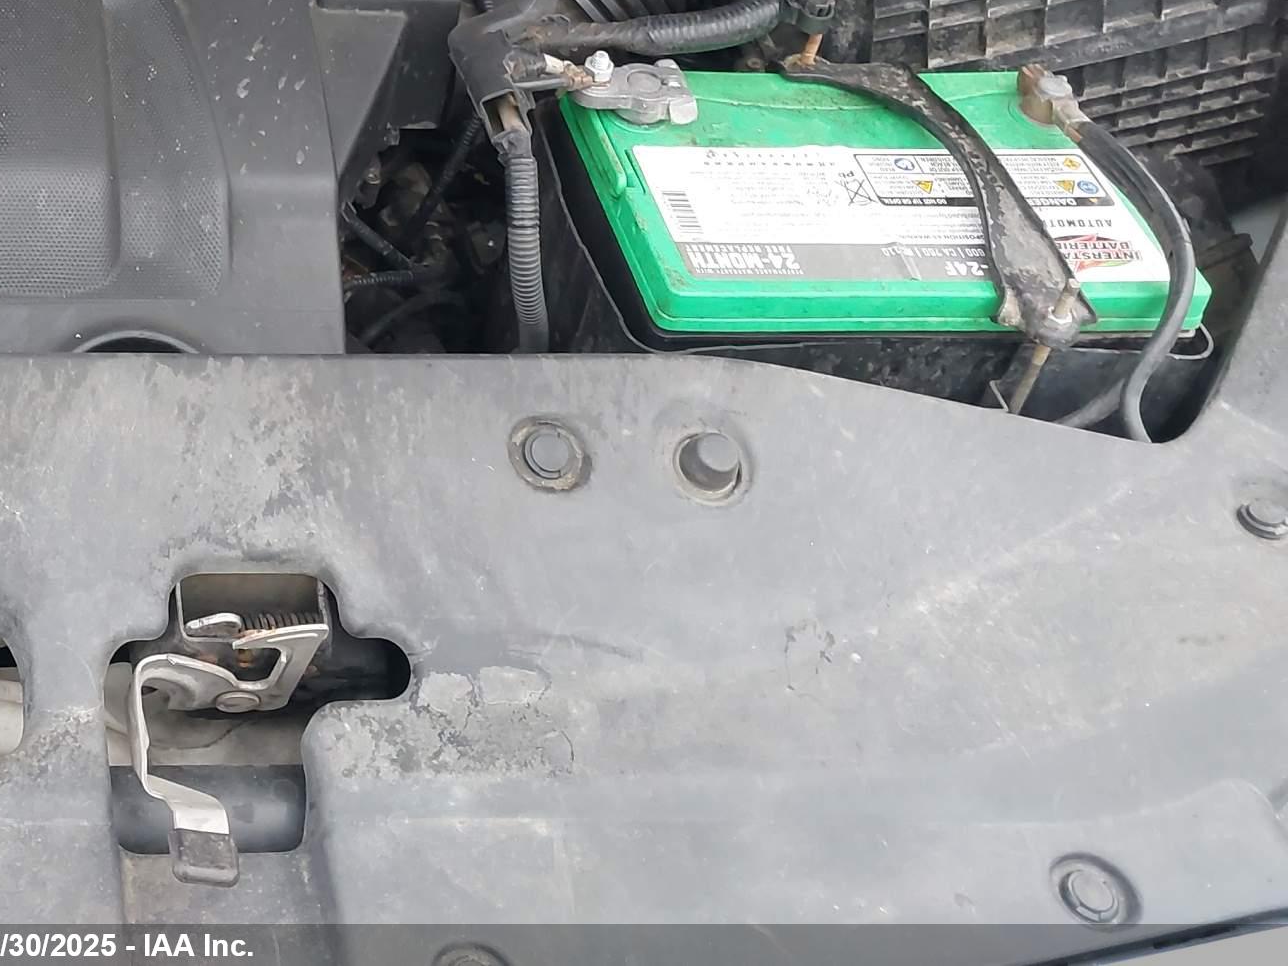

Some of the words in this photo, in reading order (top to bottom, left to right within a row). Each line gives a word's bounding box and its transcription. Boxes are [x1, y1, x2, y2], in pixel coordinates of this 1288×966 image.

[837, 170, 855, 179] Pb
[1049, 218, 1112, 228] AUTOMOT
[685, 244, 762, 253] REPLACEMENT
[764, 244, 793, 253] FREE
[1055, 241, 1130, 250] BATTERIE
[941, 248, 958, 257] CA
[1062, 250, 1141, 260] INTERSTA
[687, 251, 801, 270] 24-MONTH
